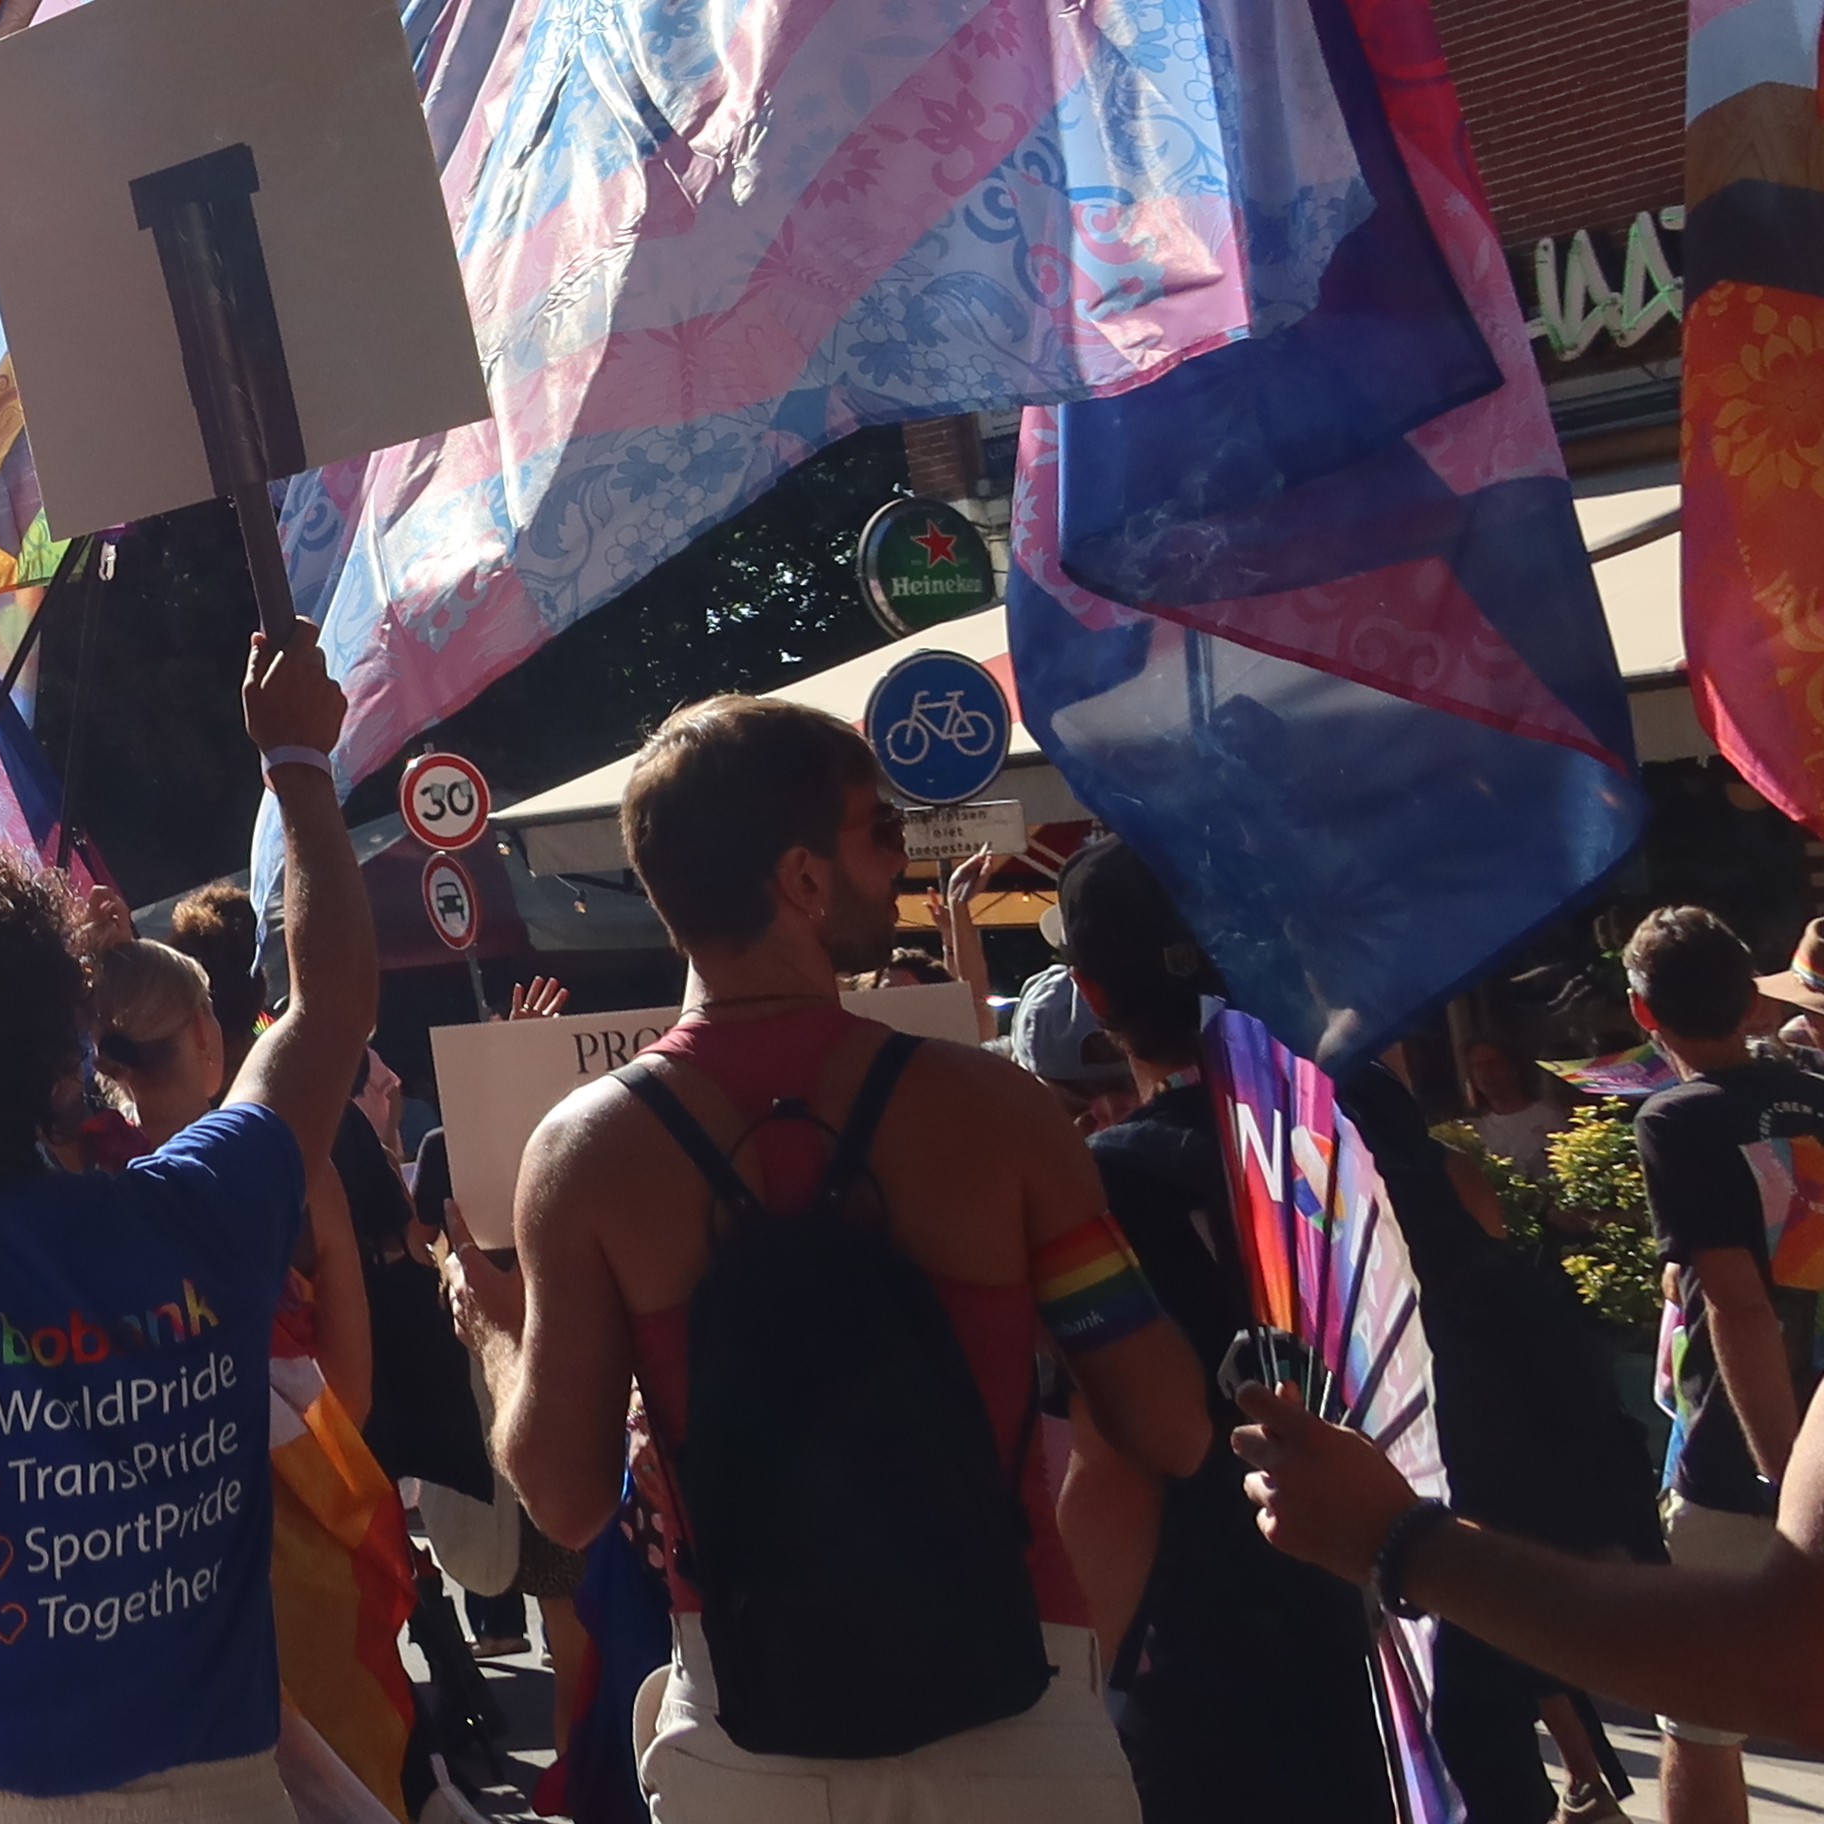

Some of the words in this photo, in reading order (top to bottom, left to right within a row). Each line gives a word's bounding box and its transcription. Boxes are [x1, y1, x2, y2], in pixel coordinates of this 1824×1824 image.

[420, 780, 474, 821] 30
[8, 1420, 239, 1503] TransPride
[25, 1478, 241, 1579] SportPride
[38, 1559, 222, 1641] Together
